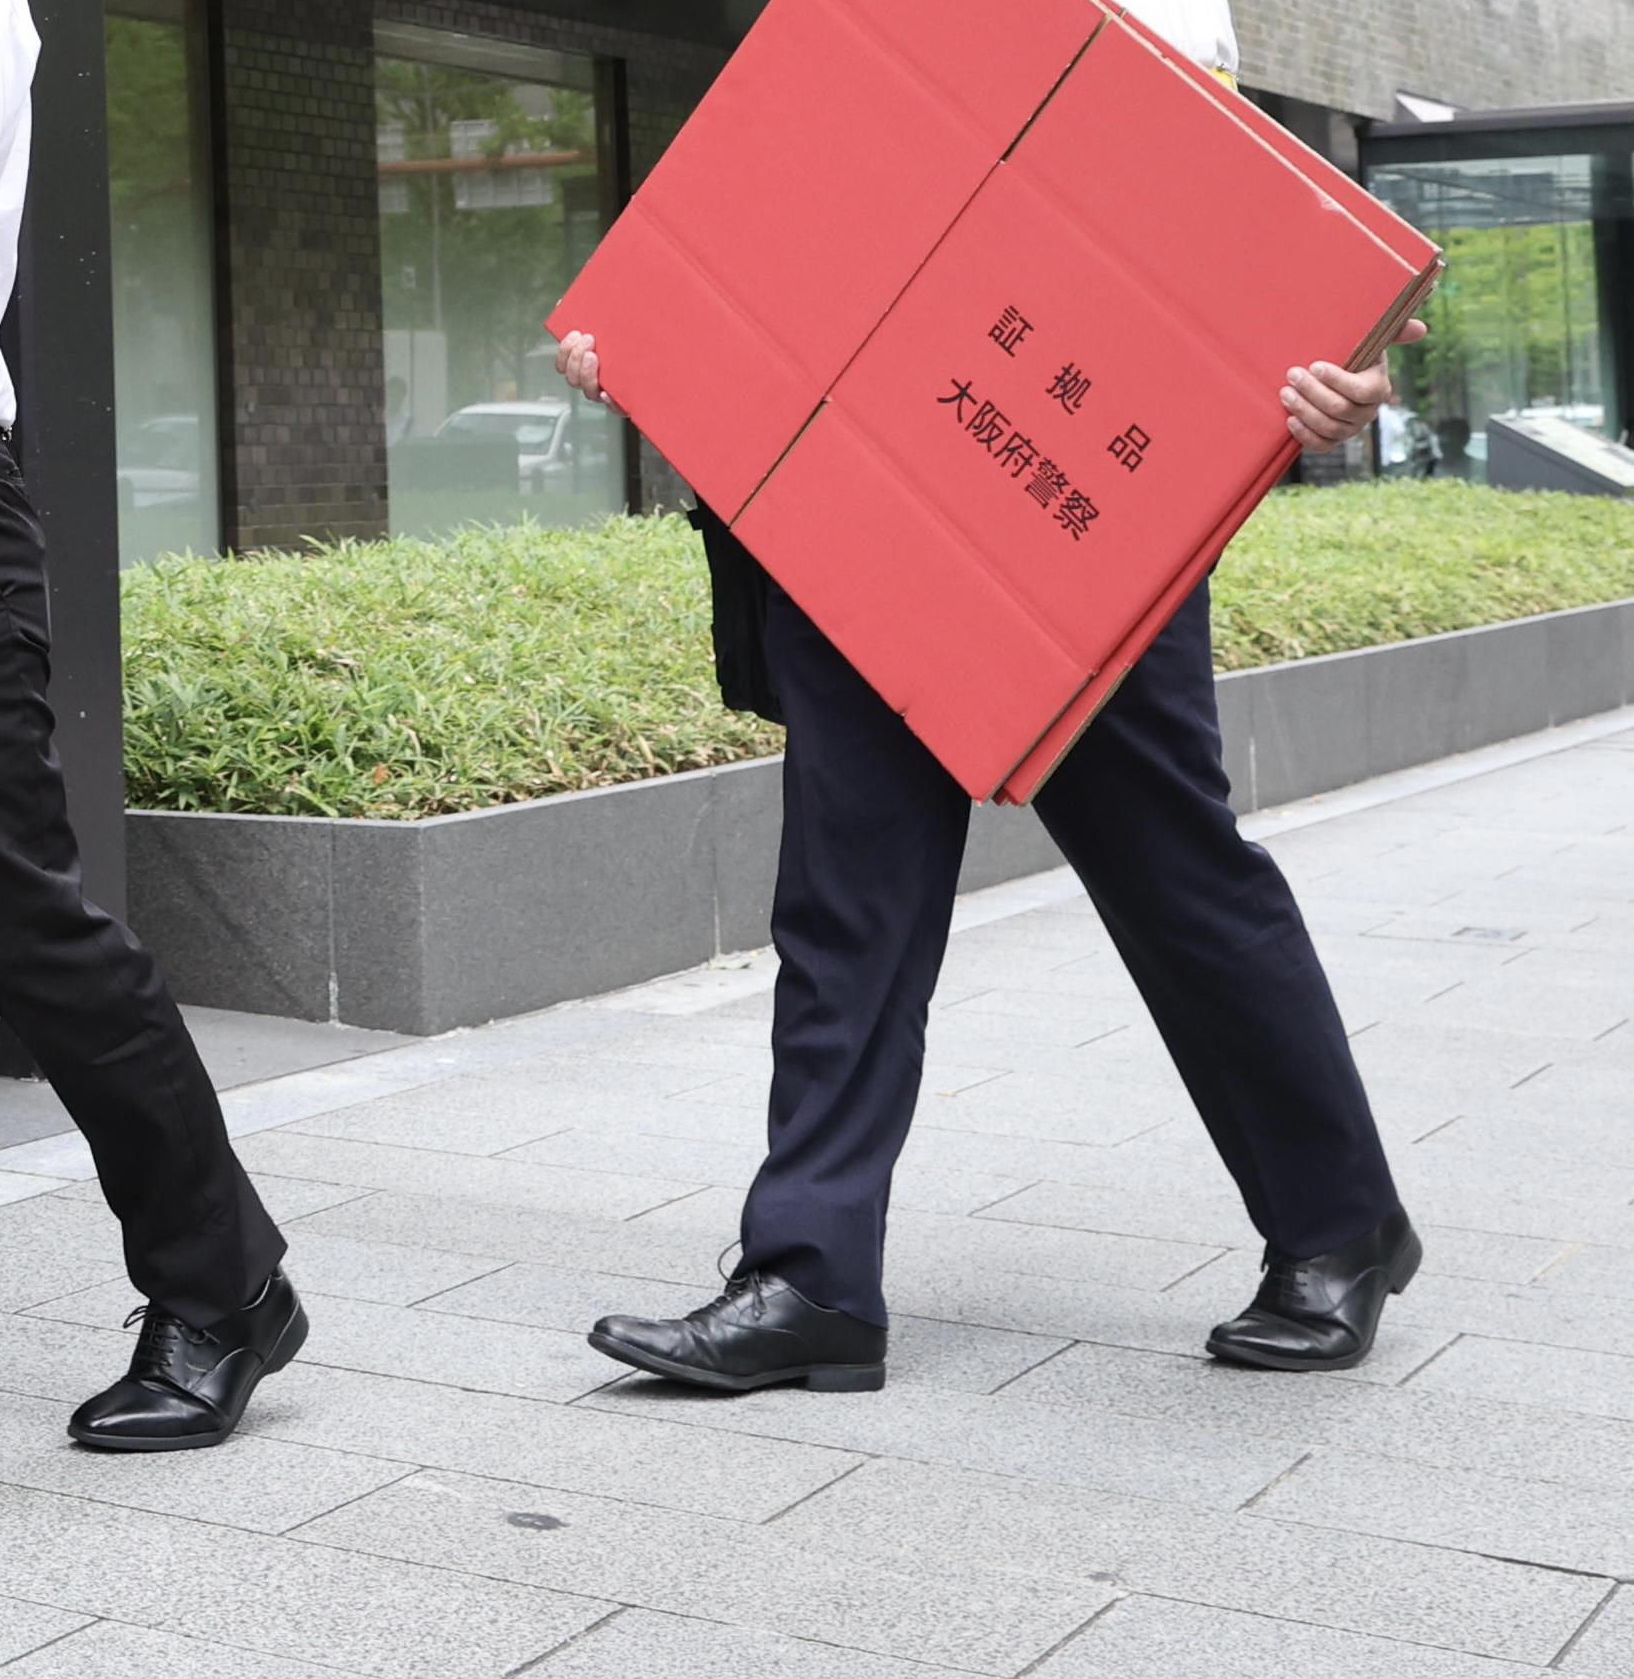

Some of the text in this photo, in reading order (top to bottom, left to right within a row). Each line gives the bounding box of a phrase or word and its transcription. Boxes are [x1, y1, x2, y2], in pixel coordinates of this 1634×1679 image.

[936, 378, 1101, 541] 大阪府警察
[987, 305, 1152, 473] 証拠品
